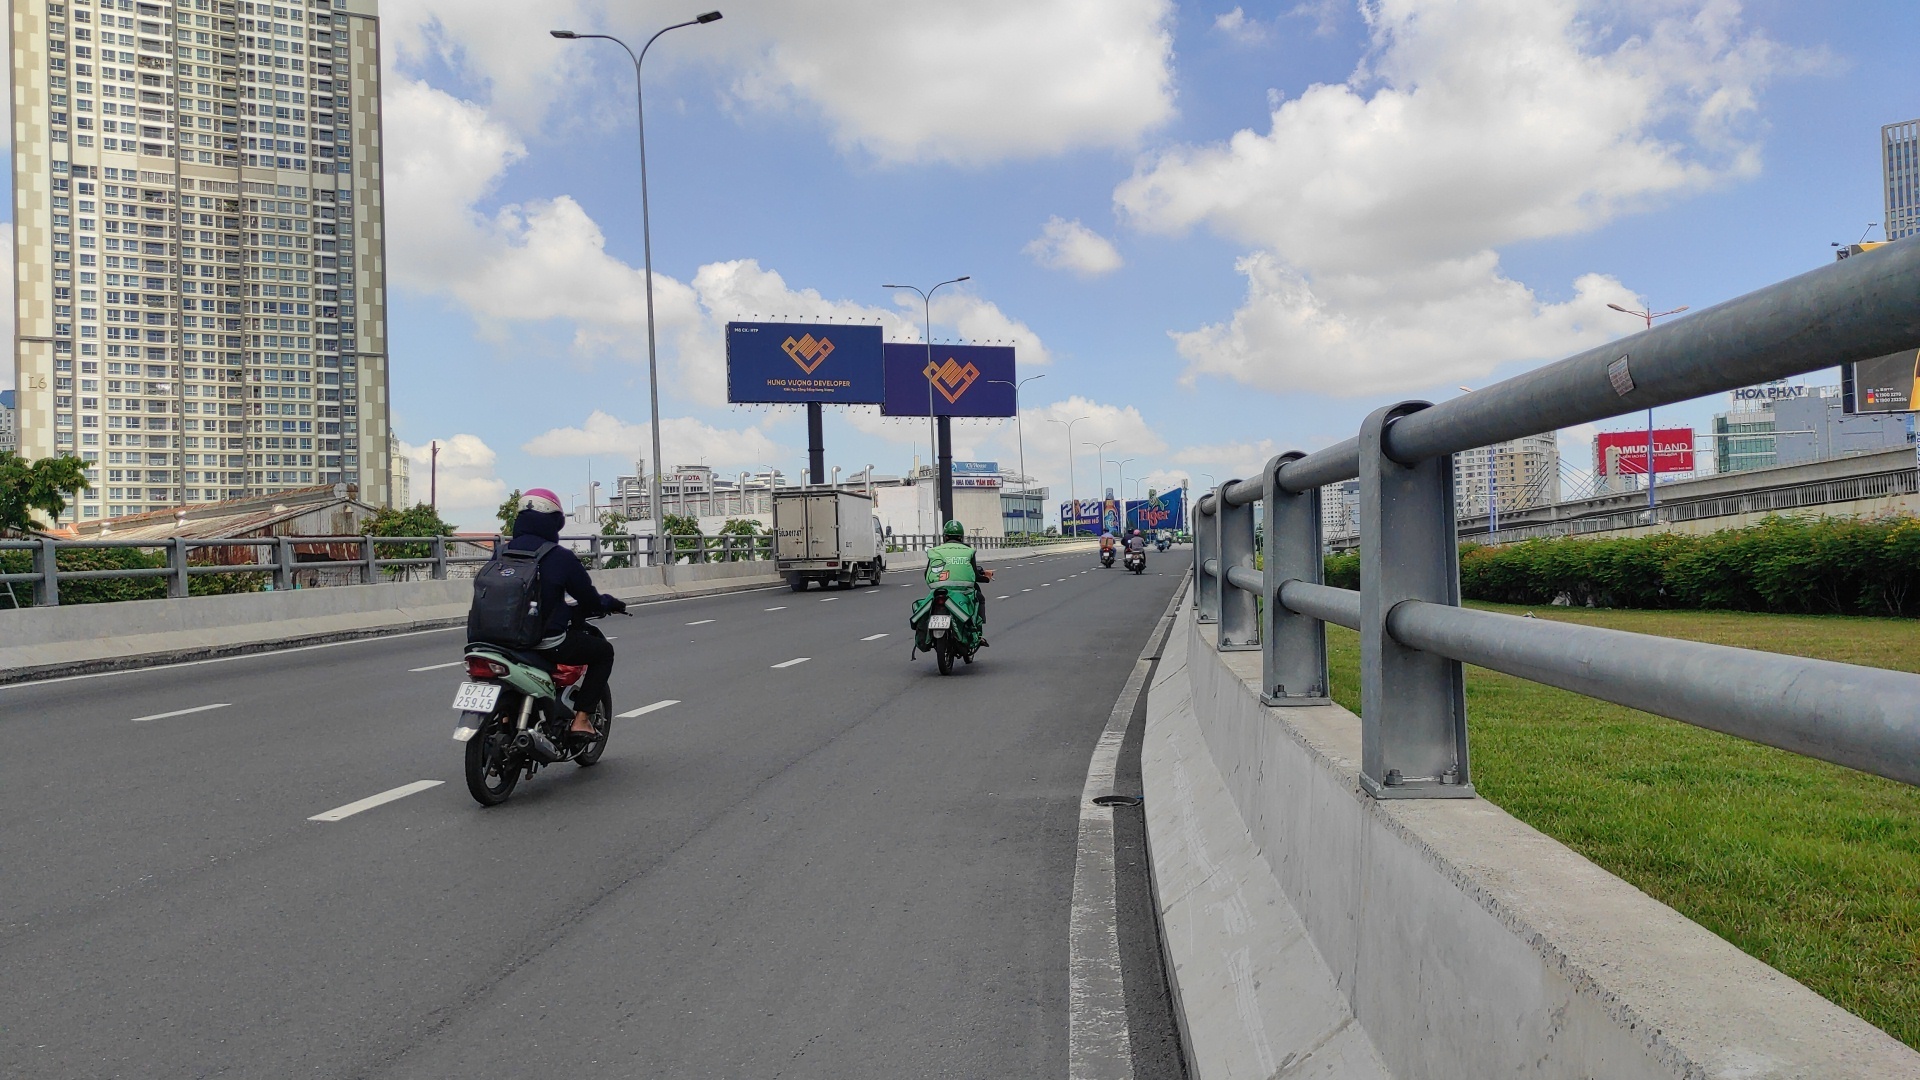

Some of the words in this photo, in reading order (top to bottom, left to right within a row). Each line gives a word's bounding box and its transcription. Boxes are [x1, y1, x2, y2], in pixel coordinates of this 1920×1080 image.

[28, 376, 47, 390] L6
[1614, 445, 1655, 454] AMUD
[1139, 506, 1170, 526] Tiger
[464, 685, 494, 698] 67-L2
[456, 696, 493, 710] 259.45
